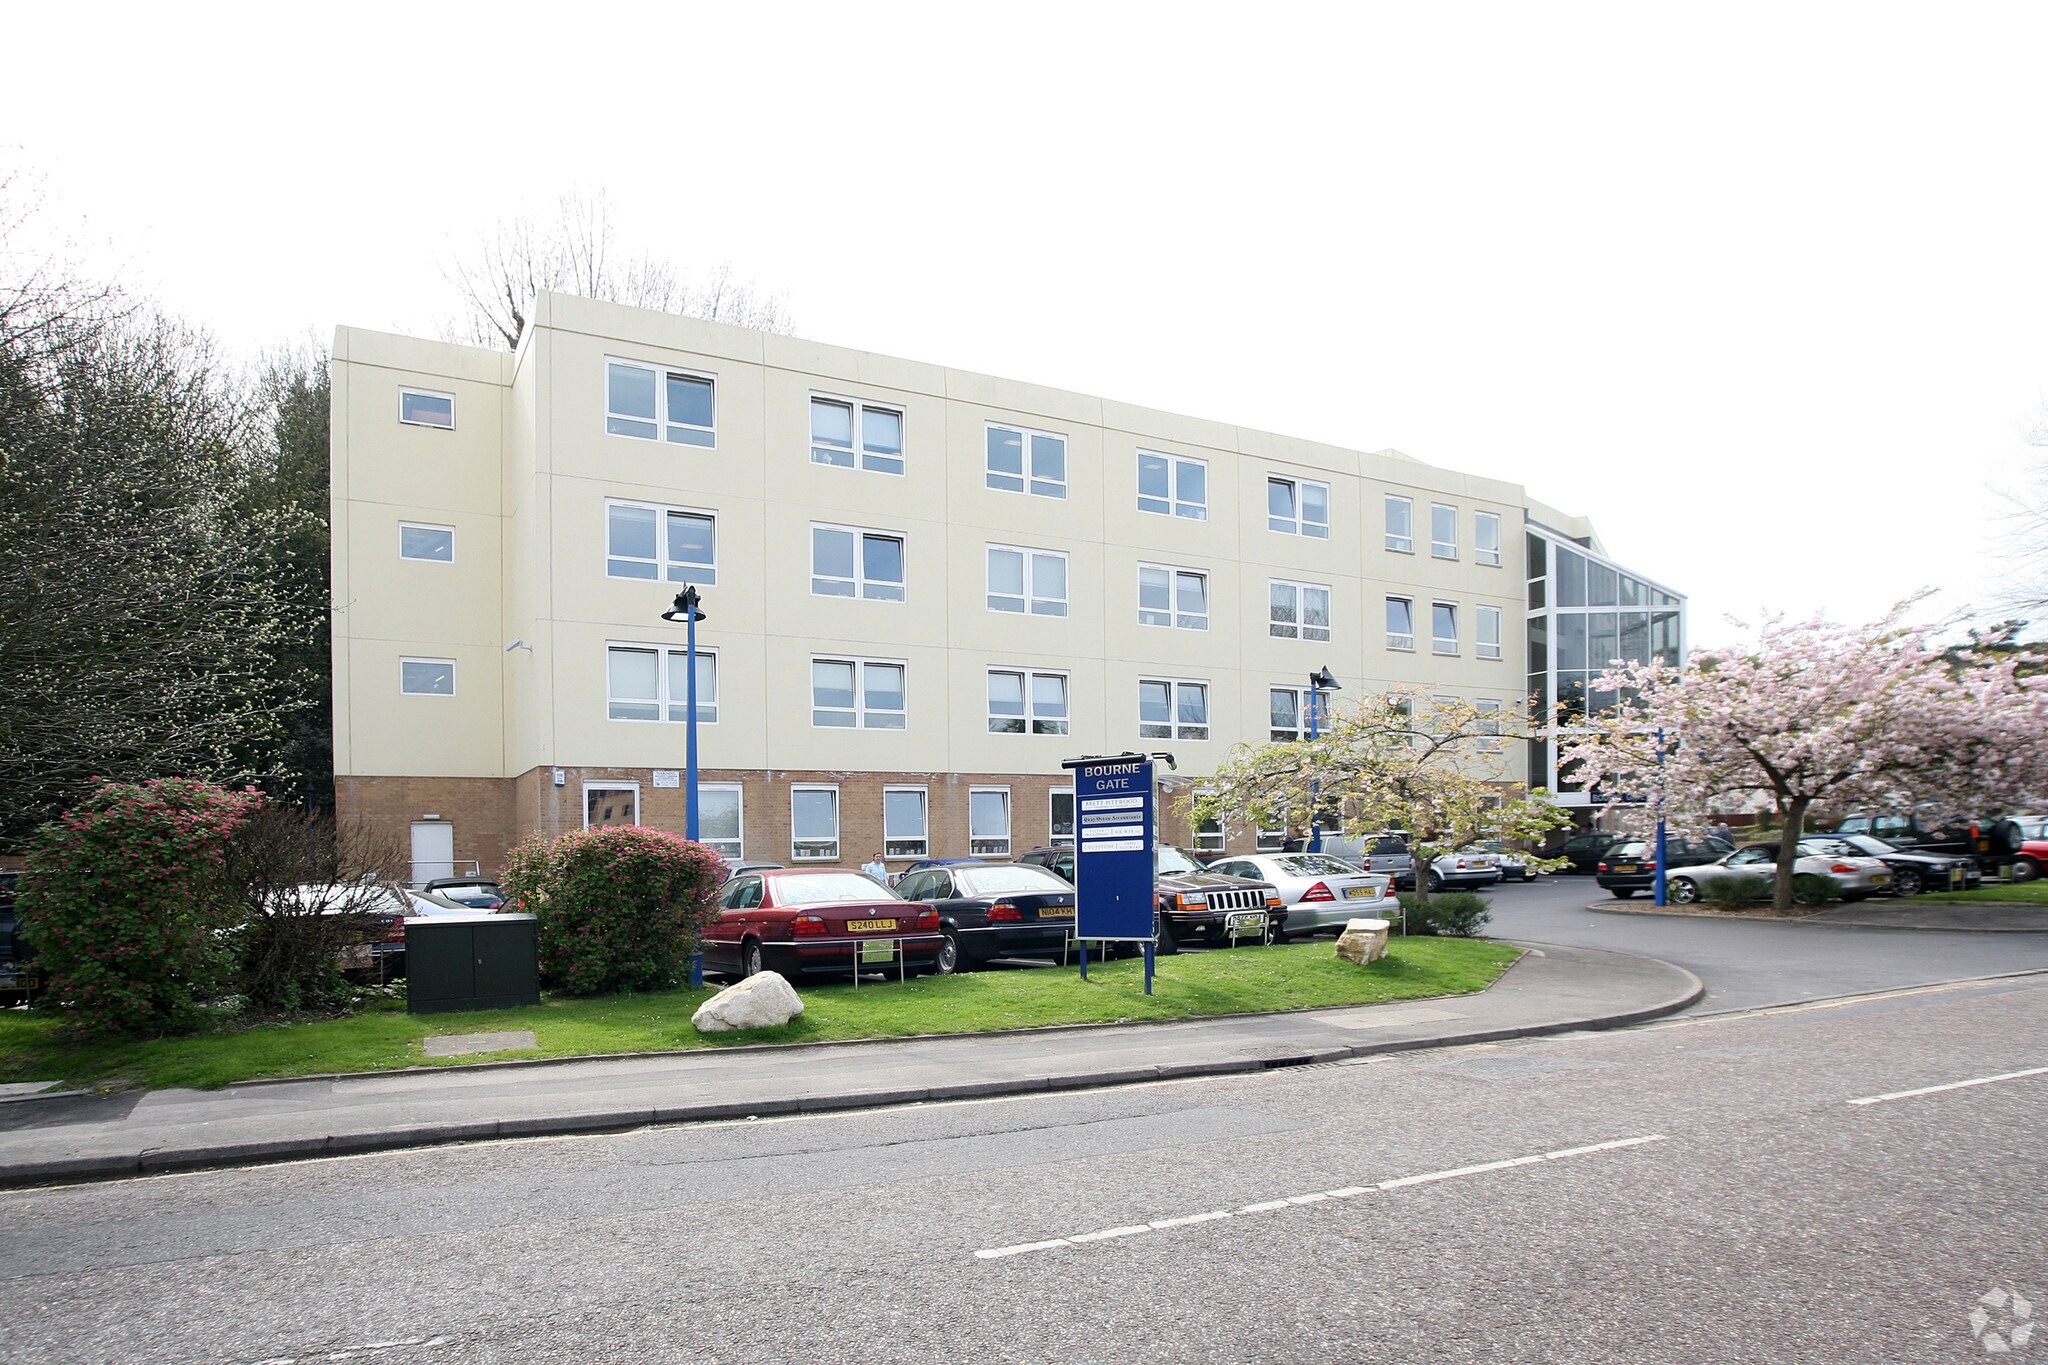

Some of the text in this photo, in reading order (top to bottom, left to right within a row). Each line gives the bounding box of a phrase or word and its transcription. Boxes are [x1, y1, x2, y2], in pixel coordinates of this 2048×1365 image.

[1084, 764, 1140, 777] BOURNE
[1096, 778, 1129, 790] GATE
[1041, 908, 1060, 916] N104
[851, 920, 893, 930] S240 LLJ
